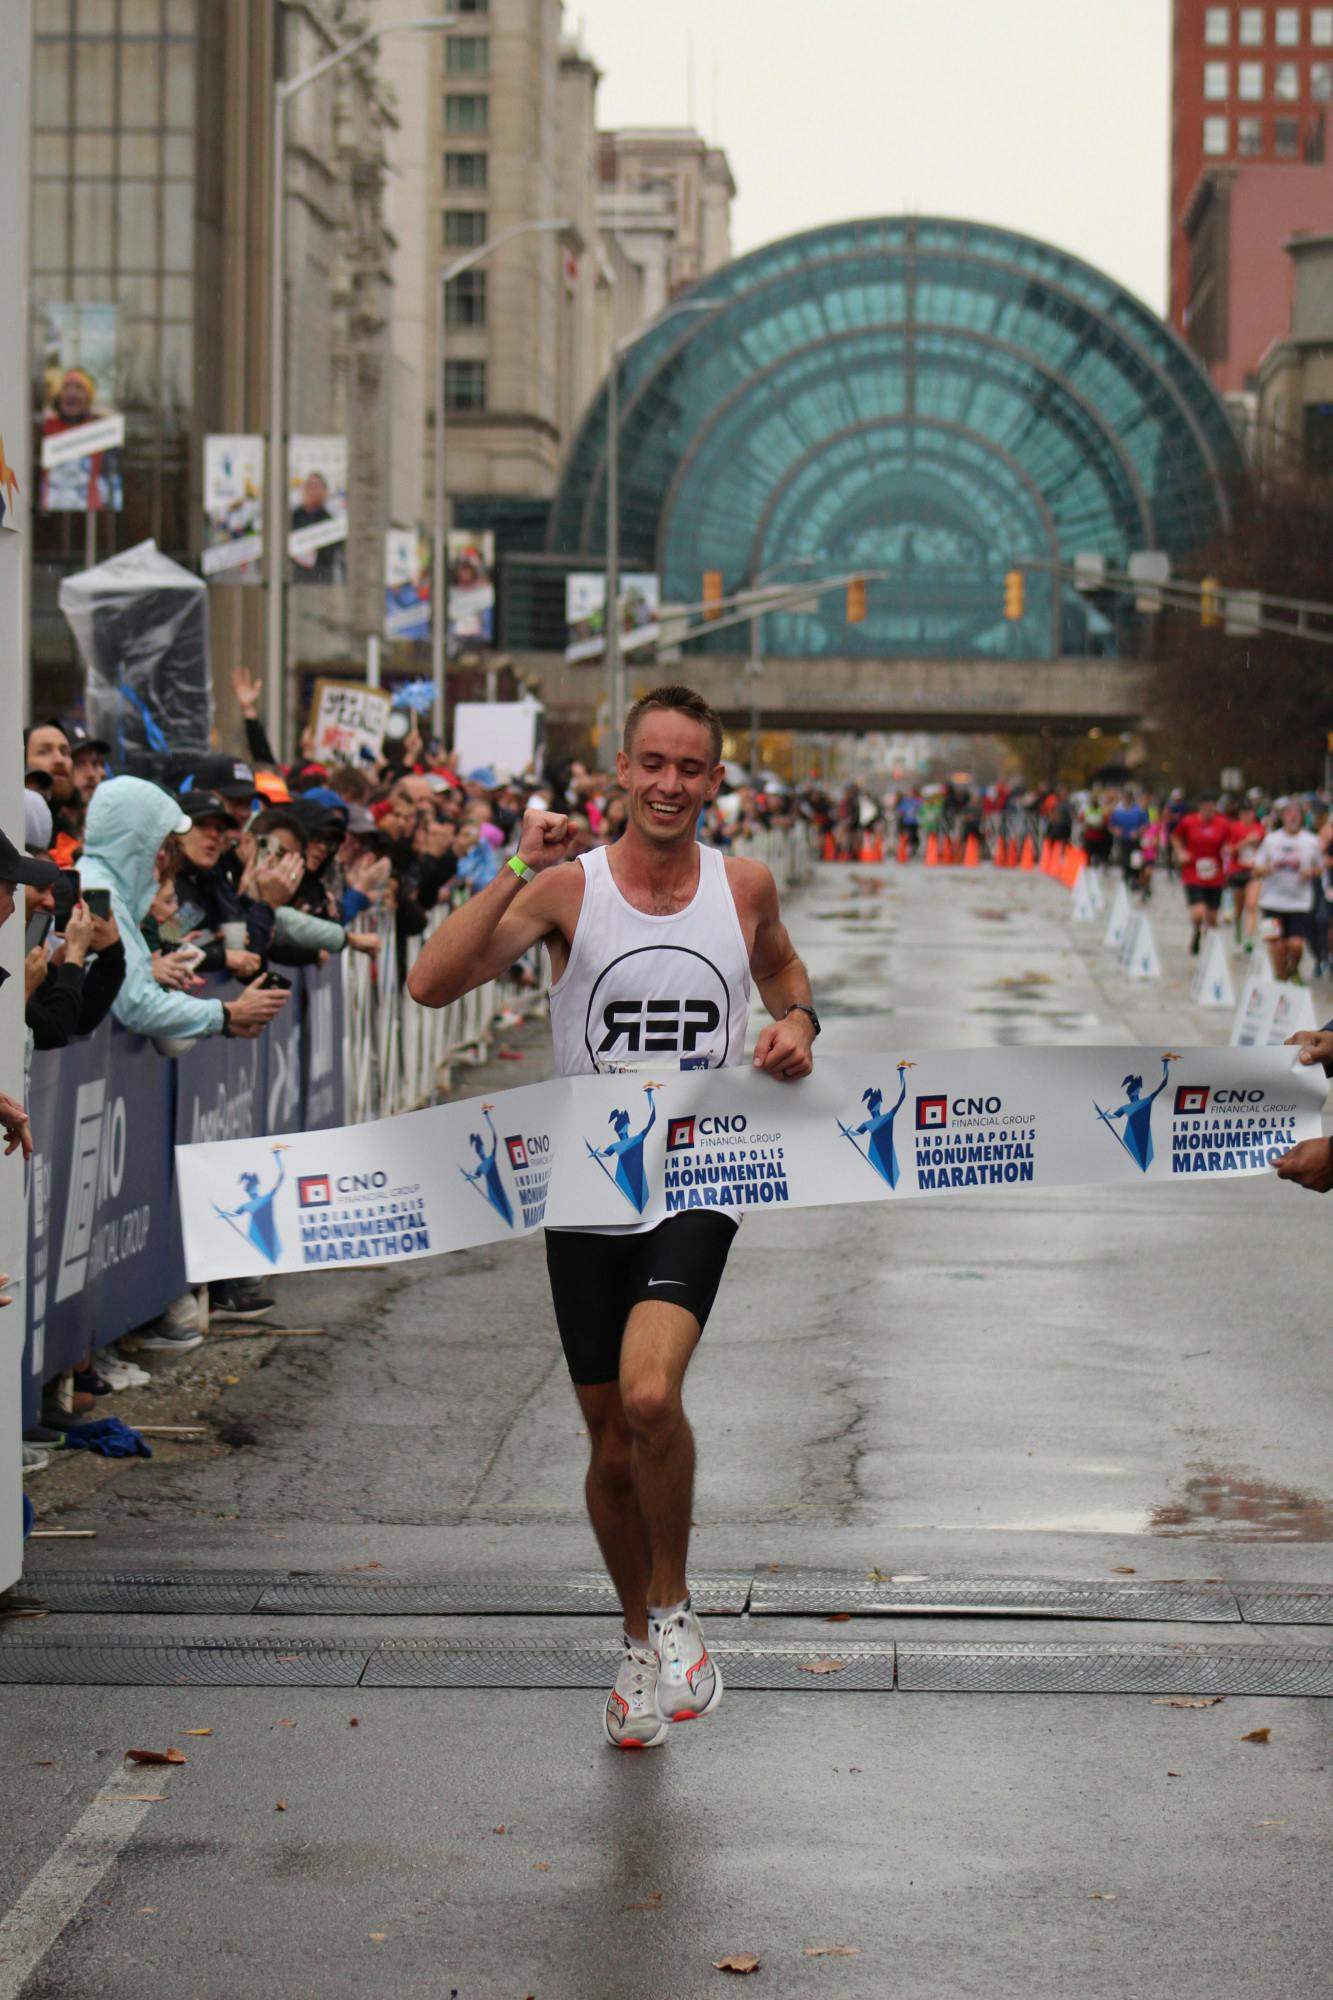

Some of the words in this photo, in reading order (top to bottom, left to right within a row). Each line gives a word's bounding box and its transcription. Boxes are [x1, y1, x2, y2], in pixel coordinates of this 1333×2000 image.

[952, 1097, 1002, 1116] CNO
[1213, 1090, 1265, 1104] CNO
[1211, 1105, 1260, 1114] FINANCIAL
[1263, 1104, 1297, 1113] GROUP
[698, 1115, 747, 1135] CNO
[951, 1118, 1000, 1128] FINANCIAL
[1002, 1115, 1036, 1125] GROUP
[1172, 1117, 1296, 1132] INDIANAPOLIS
[527, 1134, 550, 1155] CNO
[700, 1136, 748, 1148] FINANCIAL
[750, 1133, 782, 1144] GROUP
[915, 1129, 1036, 1148] INDIANAPOLIS
[1172, 1130, 1296, 1151] MONUMENTAL
[664, 1148, 784, 1170] INDIANAPOLIS
[916, 1143, 1034, 1166] MONUMENTAL
[1172, 1146, 1292, 1173] MARATHO
[336, 1171, 387, 1193] CNO
[664, 1162, 787, 1188] MONUMENTAL
[917, 1161, 1034, 1190] MARATHON
[665, 1181, 789, 1211] MARATHON
[299, 1198, 424, 1225] INDIANAPOLIS
[301, 1211, 427, 1242] MONUMENTAL
[303, 1230, 430, 1264] MARATHON
